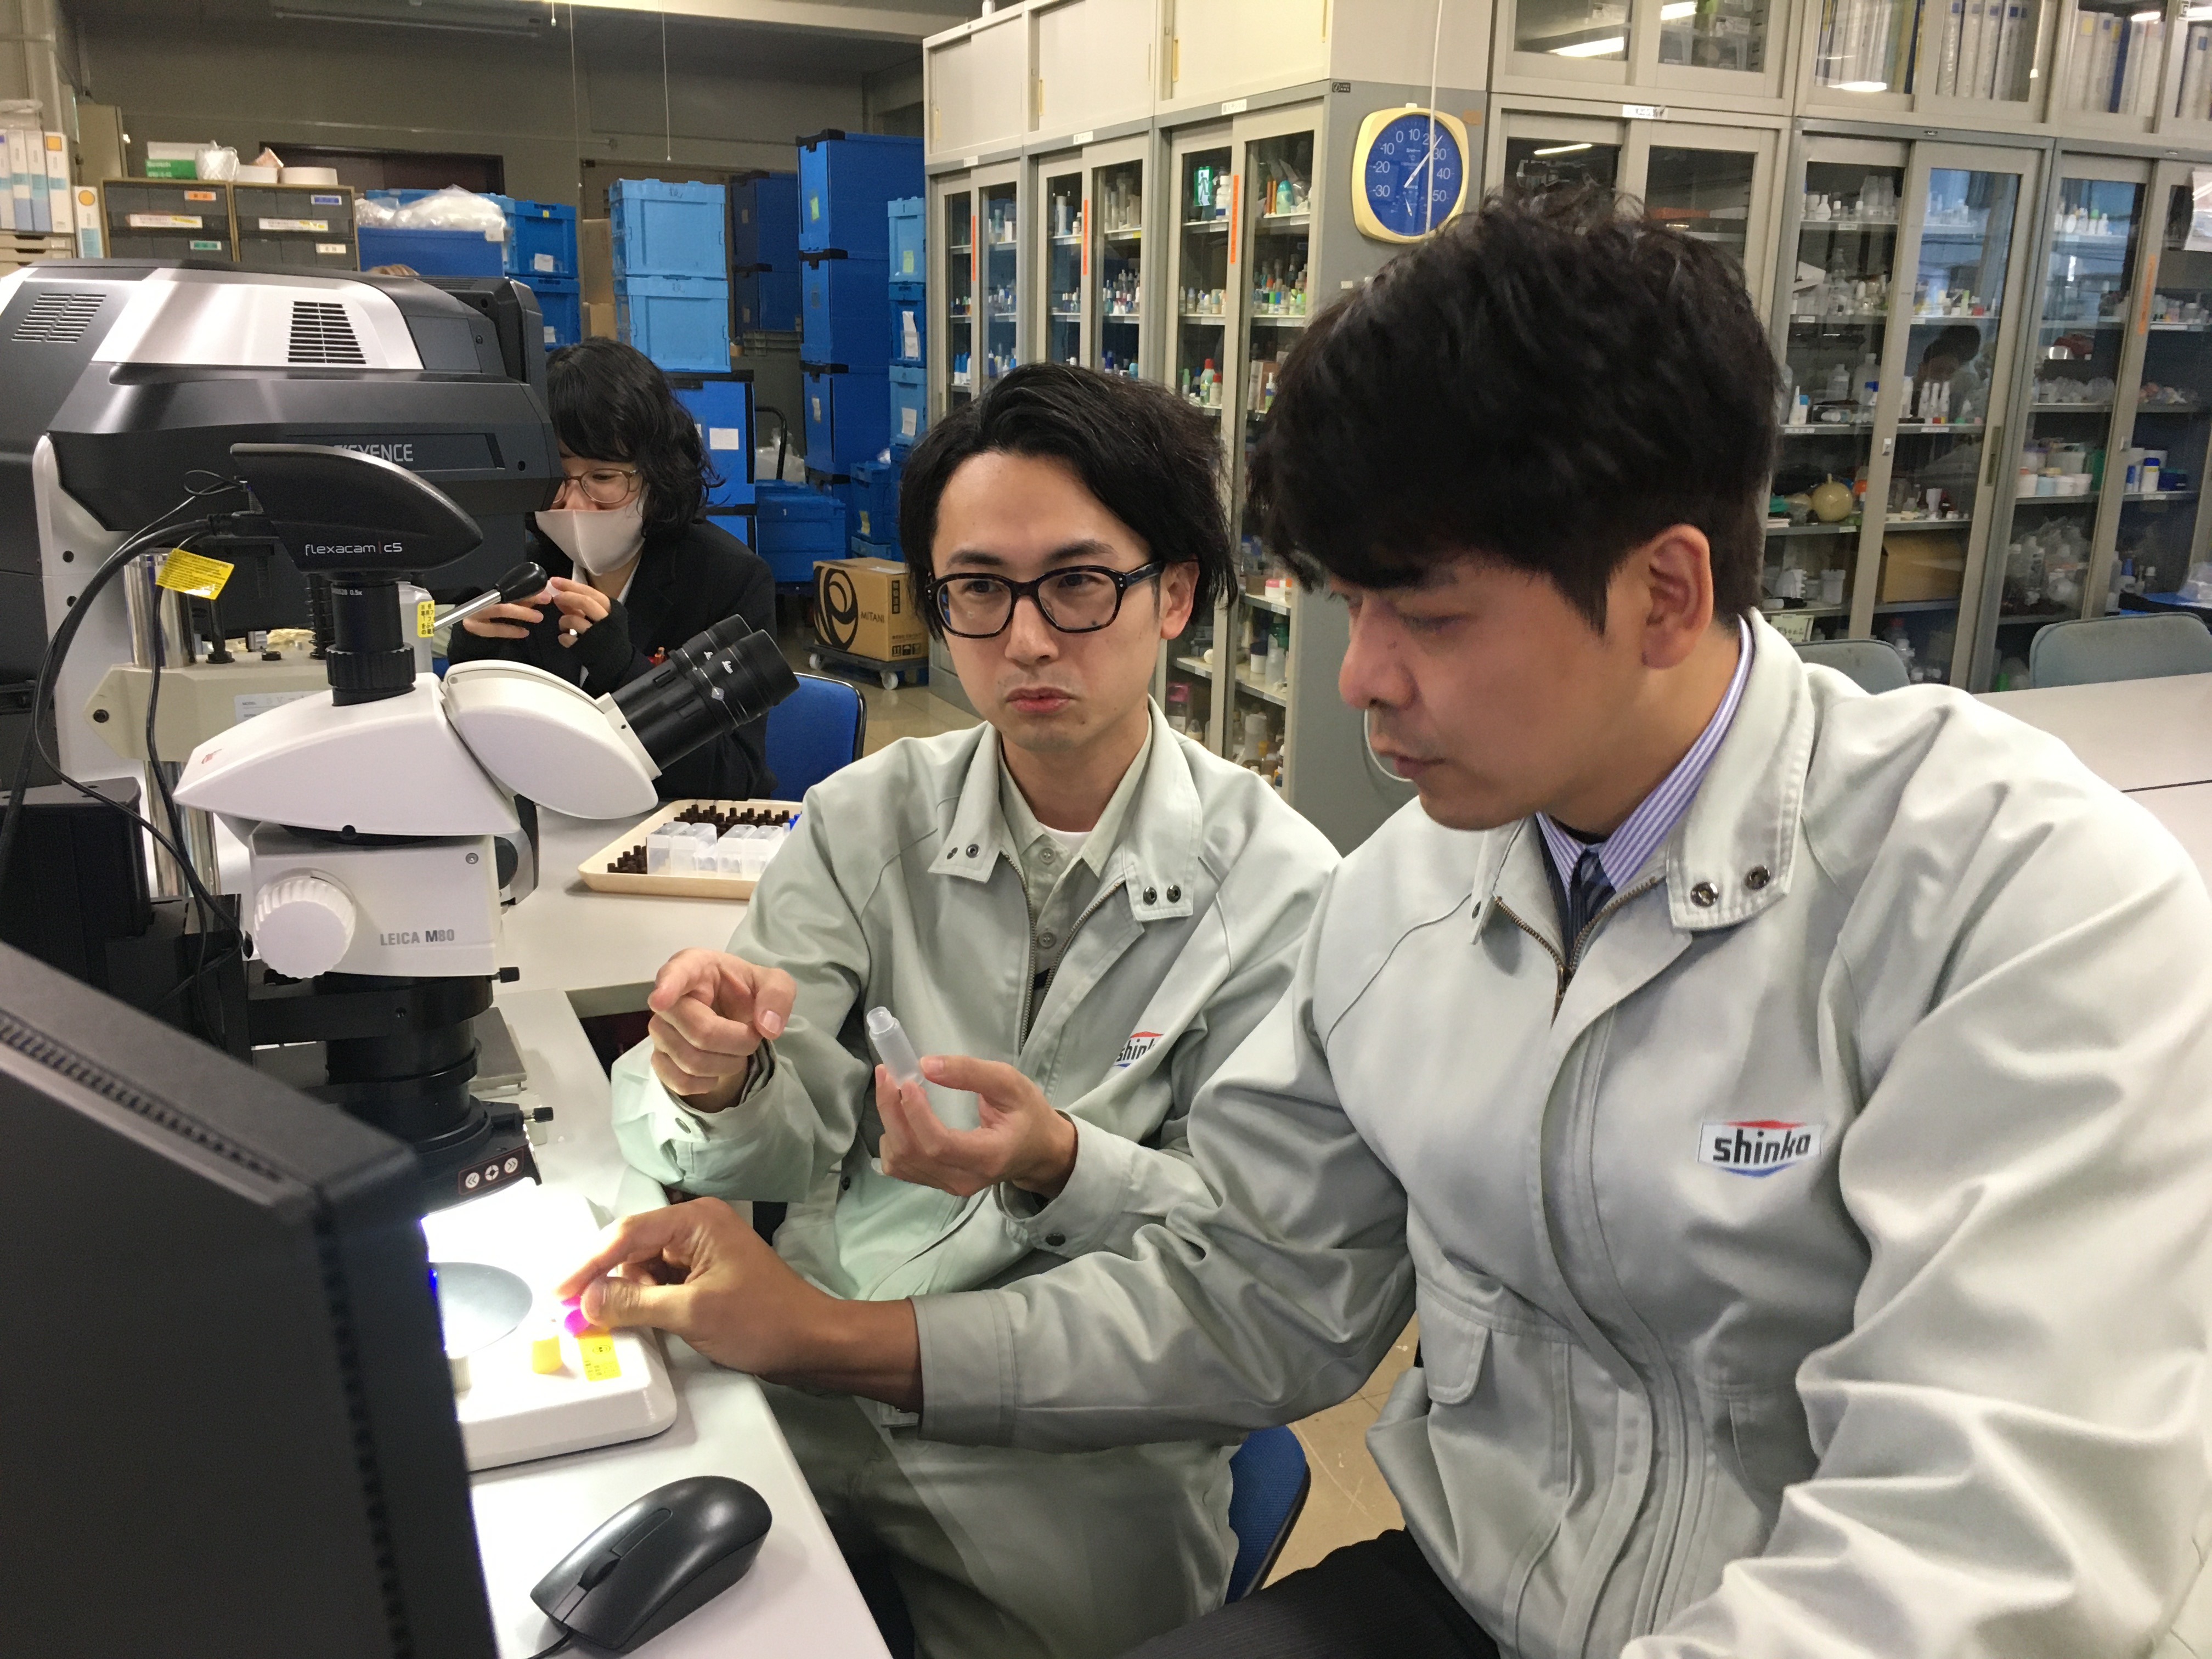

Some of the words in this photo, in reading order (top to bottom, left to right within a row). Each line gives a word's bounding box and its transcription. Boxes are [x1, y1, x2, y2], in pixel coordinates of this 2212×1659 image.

[1396, 131, 1404, 143] 0
[1409, 128, 1420, 141] 10
[1380, 143, 1395, 155] -10
[1433, 148, 1447, 160] 30
[1373, 161, 1390, 173] -20
[1436, 167, 1451, 179] 40
[1373, 184, 1390, 197] -30
[1432, 190, 1447, 202] 50
[334, 444, 414, 462] YENCE
[305, 544, 376, 556] flexacam
[383, 543, 403, 552] c5
[861, 611, 885, 624] MITANI
[380, 932, 420, 946] LEICA
[425, 929, 455, 943] M80
[1712, 1127, 1812, 1166] shinko
